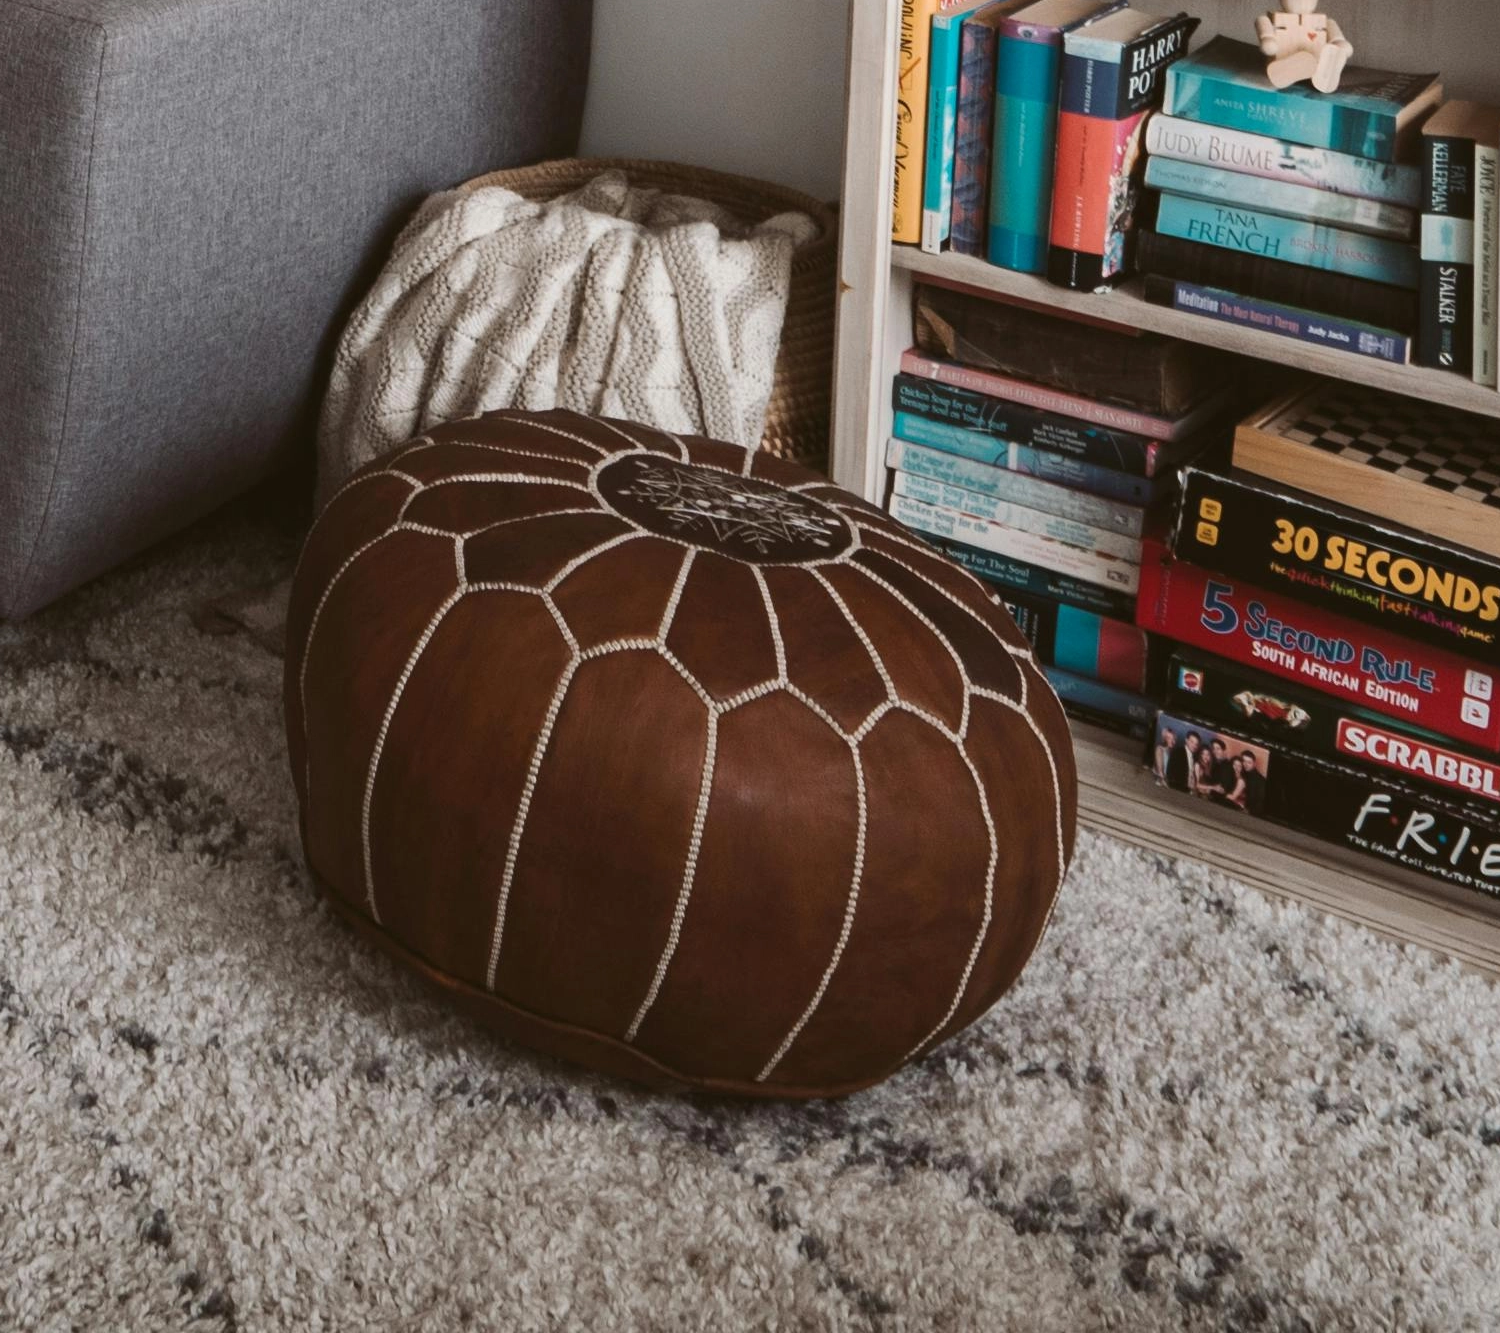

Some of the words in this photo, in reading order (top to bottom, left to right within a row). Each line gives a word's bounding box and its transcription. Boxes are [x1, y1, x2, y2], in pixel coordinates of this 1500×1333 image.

[1132, 26, 1186, 74] HARRY
[1155, 127, 1202, 154] JUDY
[1208, 136, 1273, 171] BLUME
[1431, 143, 1448, 212] KELLERMAN
[1450, 165, 1466, 193] FAYE
[1188, 219, 1280, 256] FRENCH
[1215, 209, 1258, 230] TANA
[1438, 267, 1457, 323] STALKER
[1271, 518, 1319, 562] 30
[1200, 579, 1239, 635] 5
[1243, 601, 1355, 667] SECOND
[1360, 647, 1436, 693] RULE
[1252, 641, 1296, 674] SOUTH
[1300, 657, 1360, 693] AFRICAN
[1365, 680, 1420, 714] EDITION
